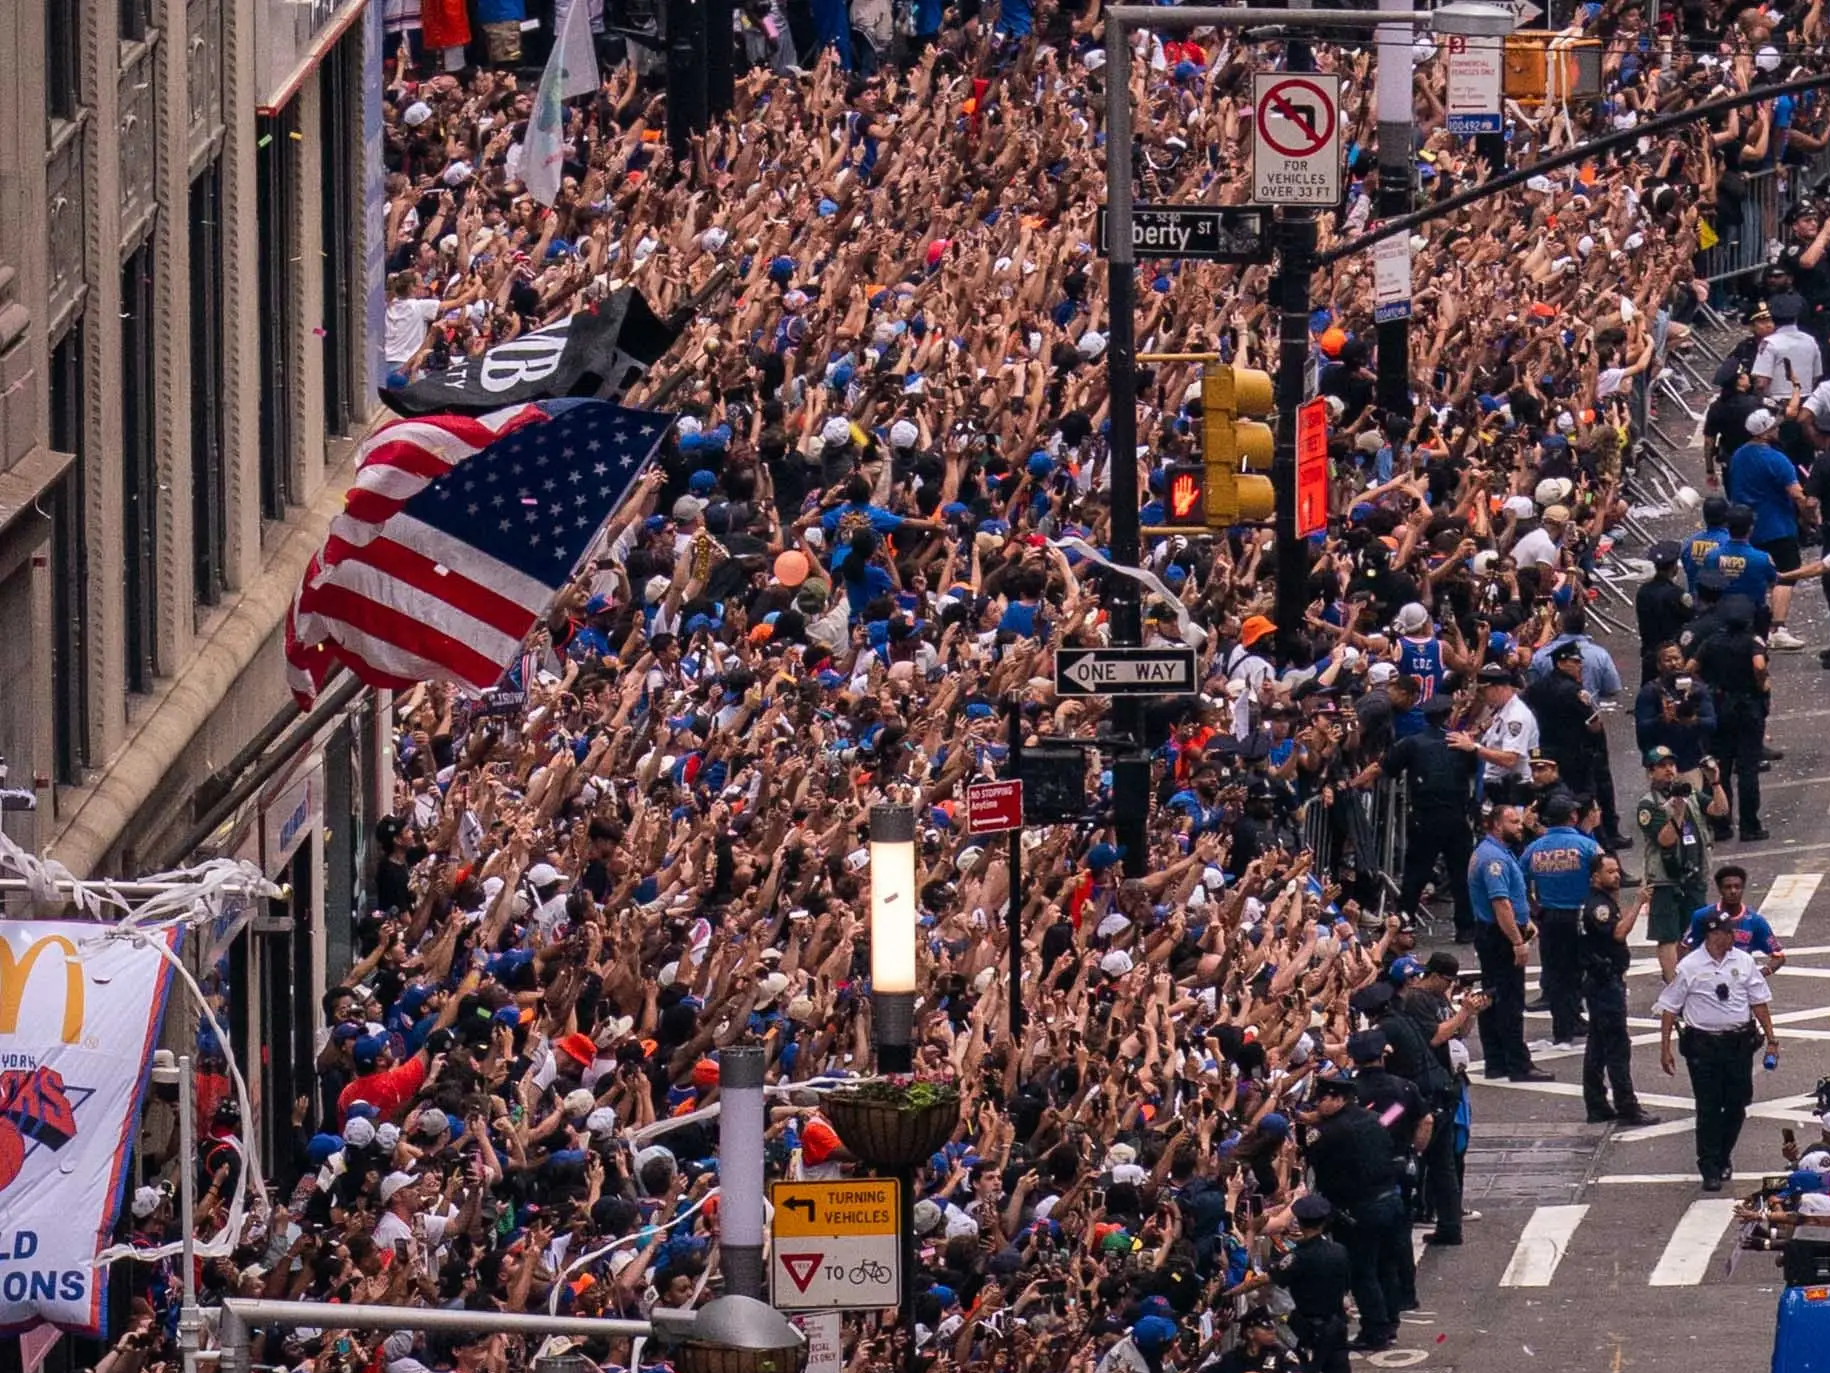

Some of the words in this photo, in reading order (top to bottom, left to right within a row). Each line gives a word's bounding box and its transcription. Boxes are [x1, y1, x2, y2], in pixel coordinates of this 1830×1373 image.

[1283, 160, 1308, 171] FOR
[1267, 173, 1326, 185] VEHICLES
[1261, 186, 1293, 197] OVER
[1298, 187, 1312, 198] 33
[1316, 187, 1330, 197] FT
[1131, 220, 1192, 251] berty
[1197, 222, 1213, 235] ST
[1078, 663, 1117, 681] ONE
[1135, 663, 1177, 680] WAY
[828, 1190, 886, 1204] TURNING
[824, 1210, 889, 1225] VEHICLES
[825, 1266, 844, 1281] TO
